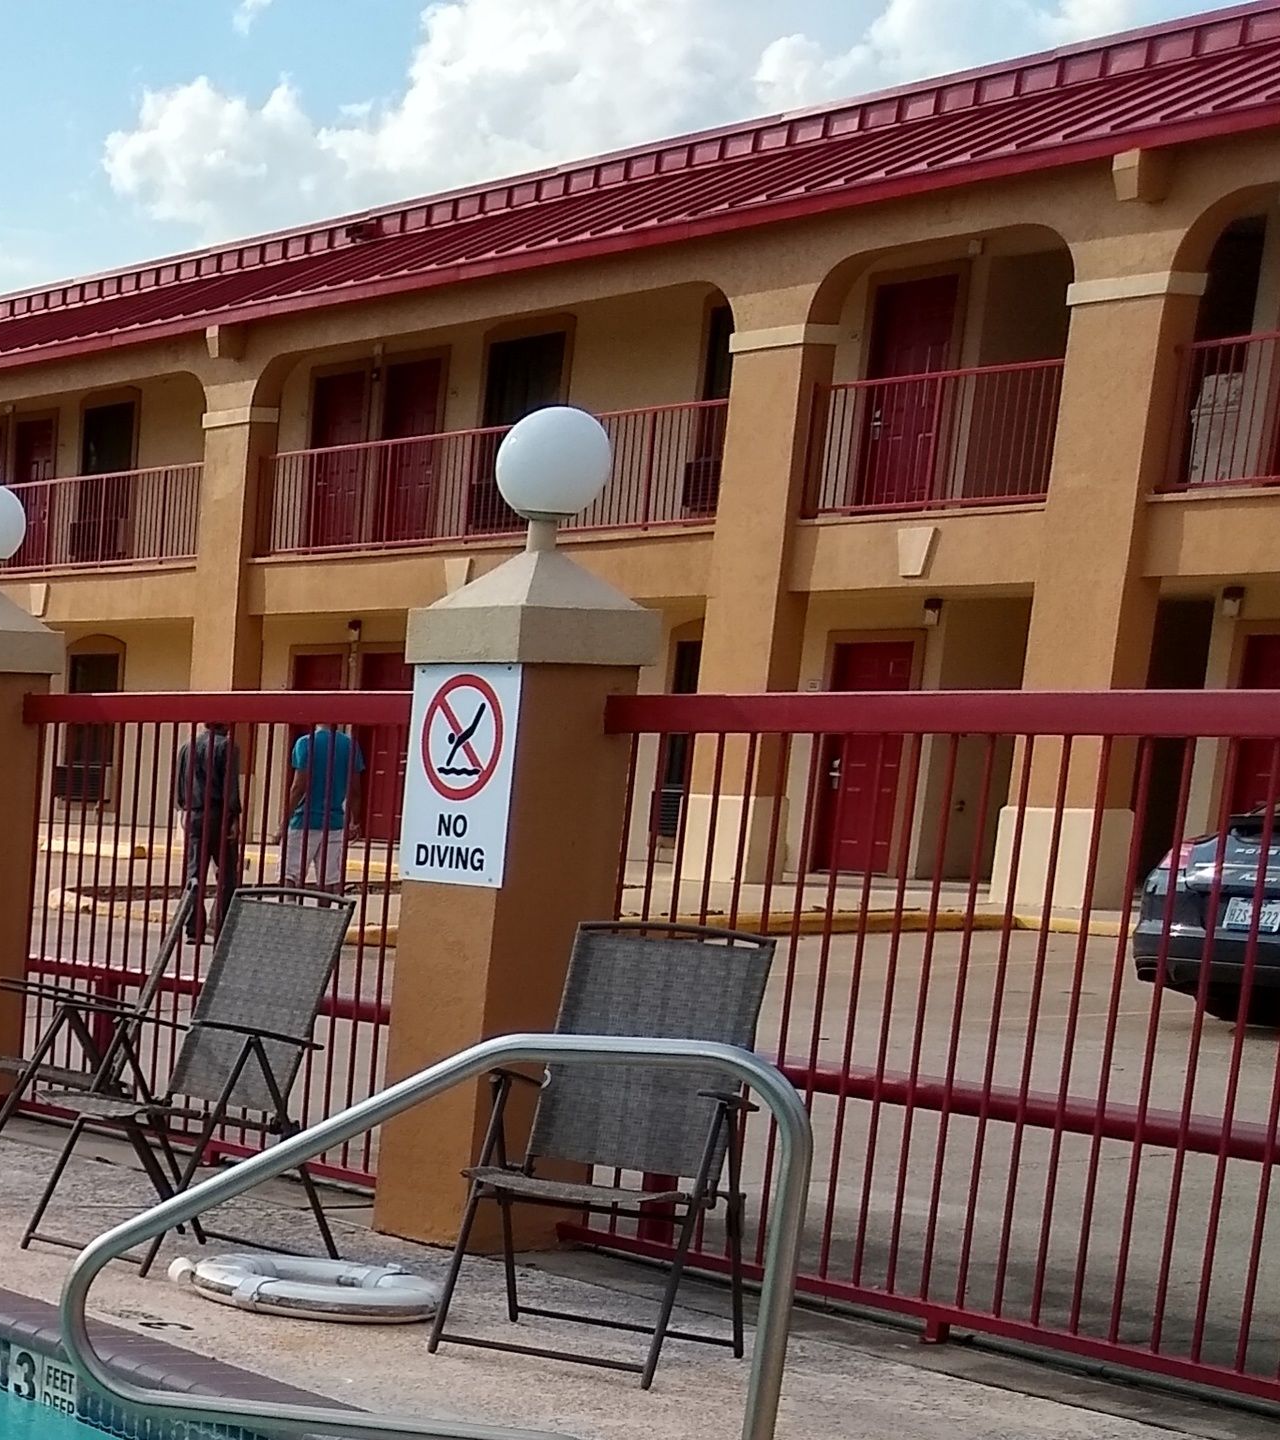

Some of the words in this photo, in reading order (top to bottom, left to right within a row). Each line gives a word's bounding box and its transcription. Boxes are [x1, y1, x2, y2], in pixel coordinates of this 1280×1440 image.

[437, 813, 468, 838] NO
[415, 844, 485, 871] DIVING
[13, 1351, 36, 1401] 3
[46, 1364, 75, 1395] FEET
[43, 1390, 75, 1415] DEEP
